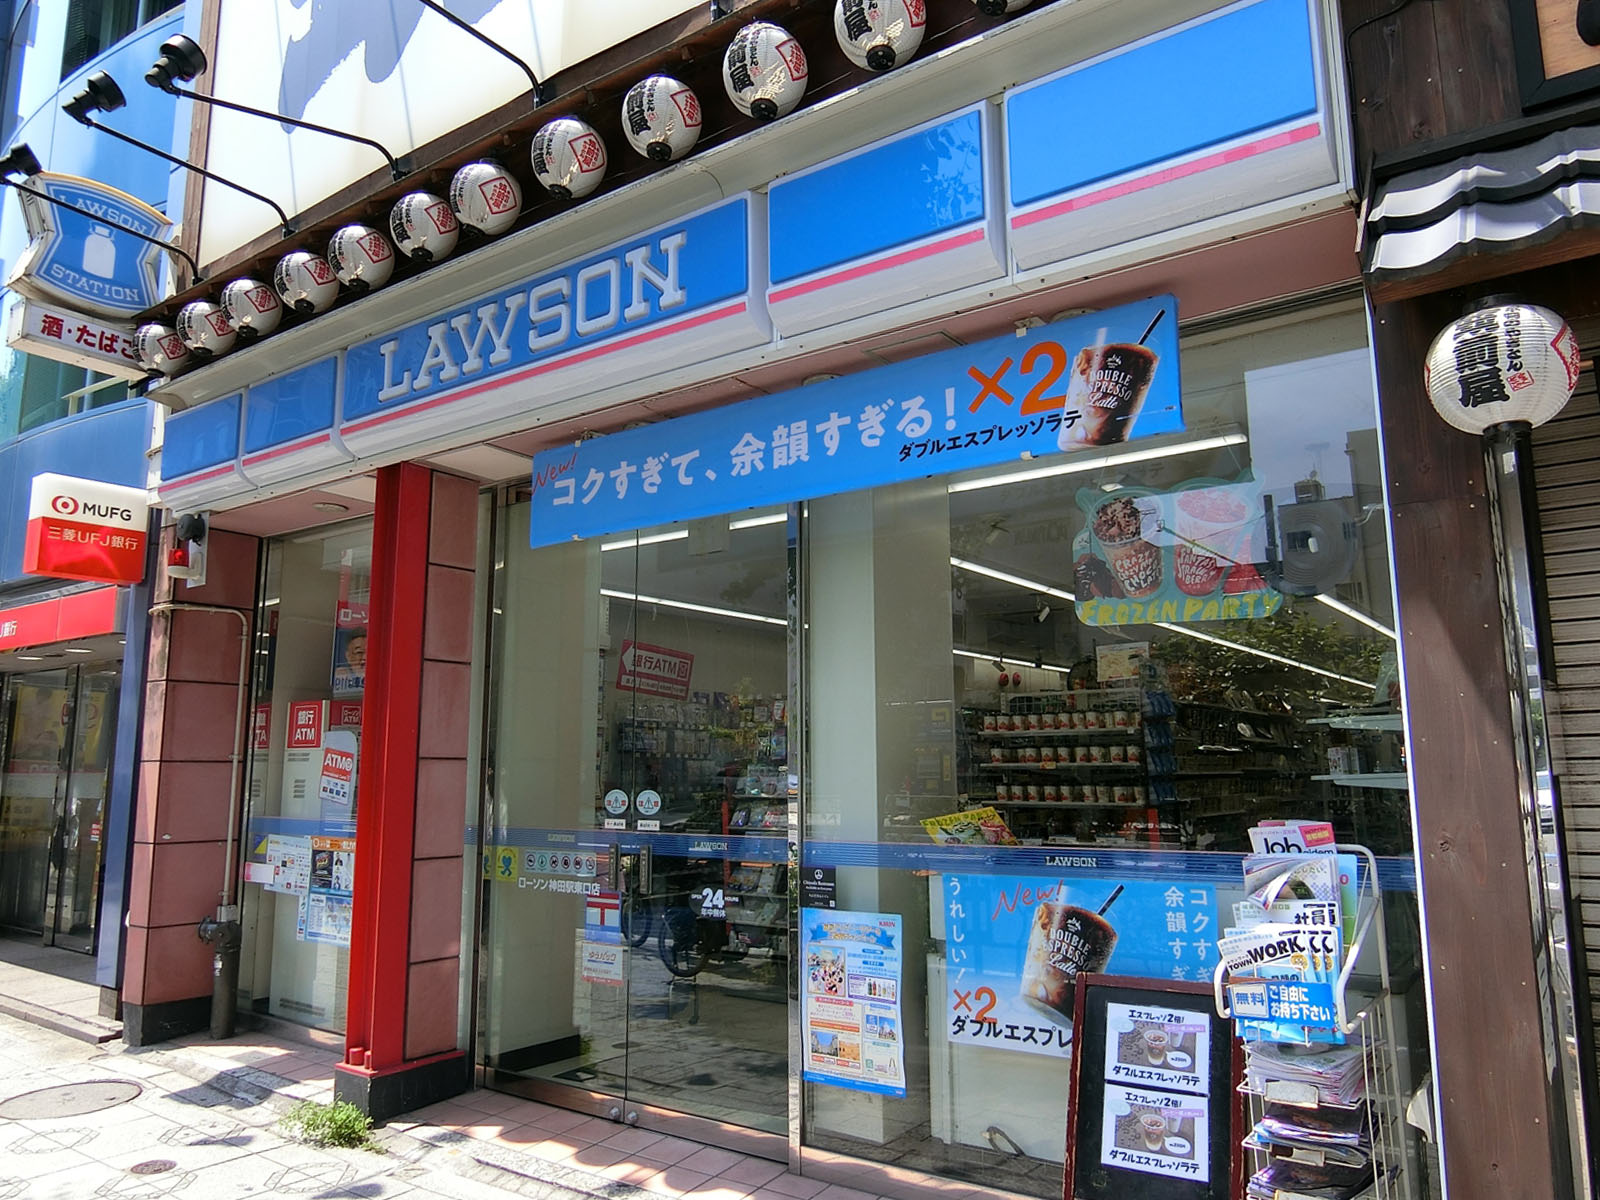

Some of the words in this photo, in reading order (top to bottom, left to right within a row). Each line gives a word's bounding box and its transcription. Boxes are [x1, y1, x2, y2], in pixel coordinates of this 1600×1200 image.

[50, 263, 140, 301] STATION
[378, 230, 687, 401] LAWSON
[1092, 369, 1133, 387] OUBLE
[1089, 392, 1118, 409] Latte
[899, 410, 1082, 462] ダブルエスプレッソラテ
[532, 452, 577, 496] New!
[83, 502, 132, 521] MUFG
[47, 526, 138, 550] 三菱UFJ銀行
[1081, 598, 1178, 626] FROZEN
[1184, 594, 1280, 620] PARTY
[297, 710, 314, 724] 銀行
[295, 728, 315, 741] ATM
[325, 754, 346, 770] ATM
[694, 841, 728, 850] LAWSON
[1045, 857, 1097, 868] LAWSON
[518, 877, 600, 896] ローソン神田駅東口店
[702, 887, 725, 908] 24
[991, 880, 1064, 920] New!
[1248, 936, 1305, 963] WORK
[1049, 952, 1077, 976] Latte
[1228, 958, 1252, 971] TOWN
[1235, 992, 1265, 1006] 無料
[1269, 985, 1309, 999] ご自由に
[1270, 1003, 1330, 1021] お持ち下さい
[952, 1015, 1073, 1049] ダブルエスプレ
[1113, 1065, 1200, 1086] ダブルエスプレッソラテ
[1109, 1149, 1200, 1173] ダブルエスプレッソラテ
